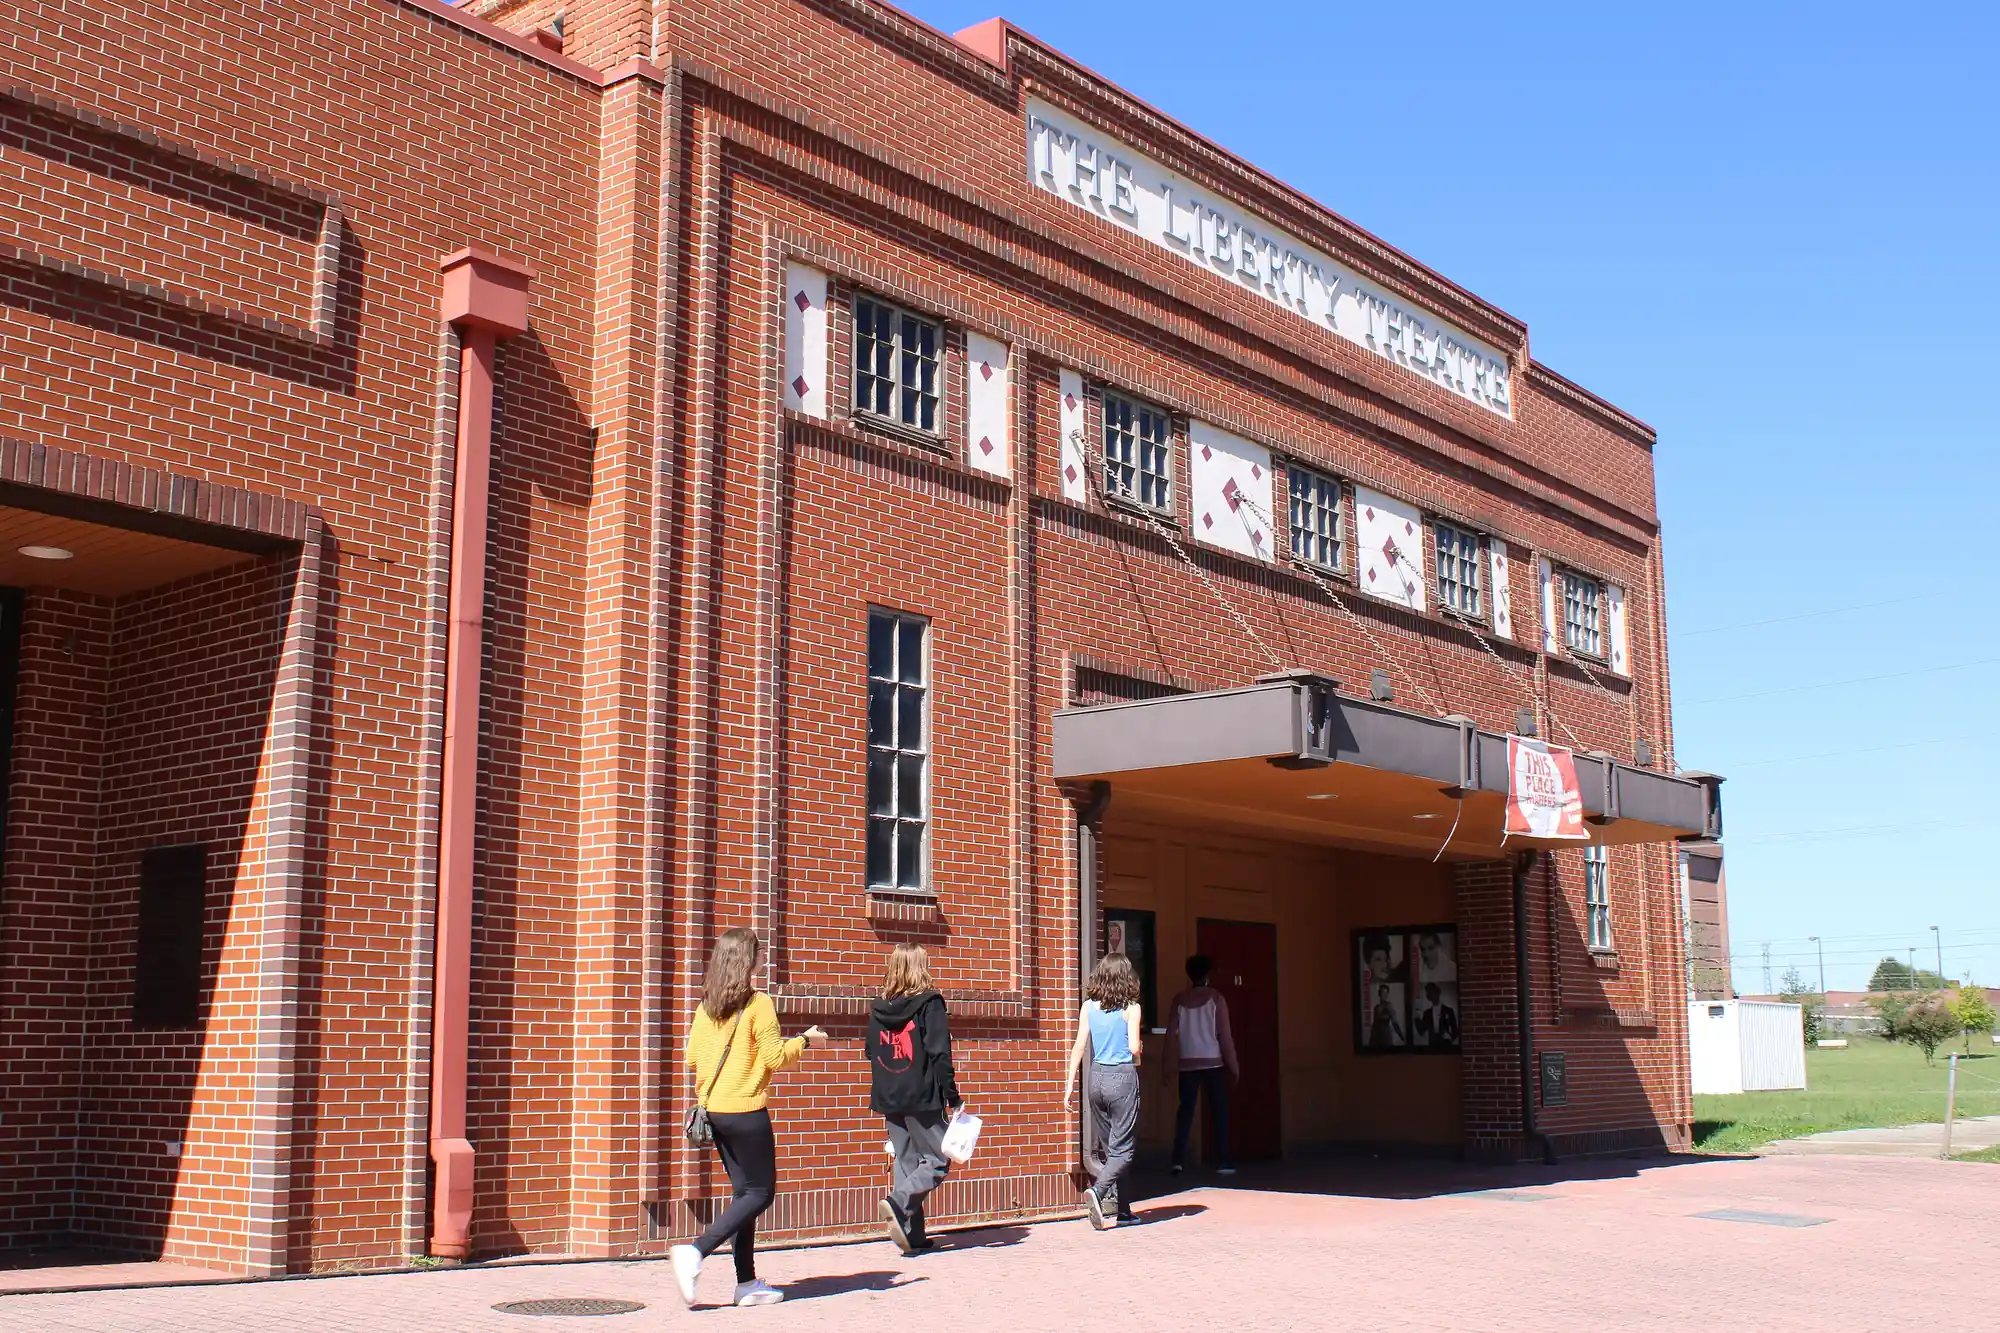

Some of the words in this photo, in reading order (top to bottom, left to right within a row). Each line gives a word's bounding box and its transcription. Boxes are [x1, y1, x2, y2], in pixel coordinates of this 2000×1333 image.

[1029, 113, 1135, 218] THE
[1160, 183, 1342, 319] LIBERTY
[1355, 287, 1509, 404] THEATRE
[1524, 751, 1551, 777] THIS
[1525, 776, 1556, 794] PLACE
